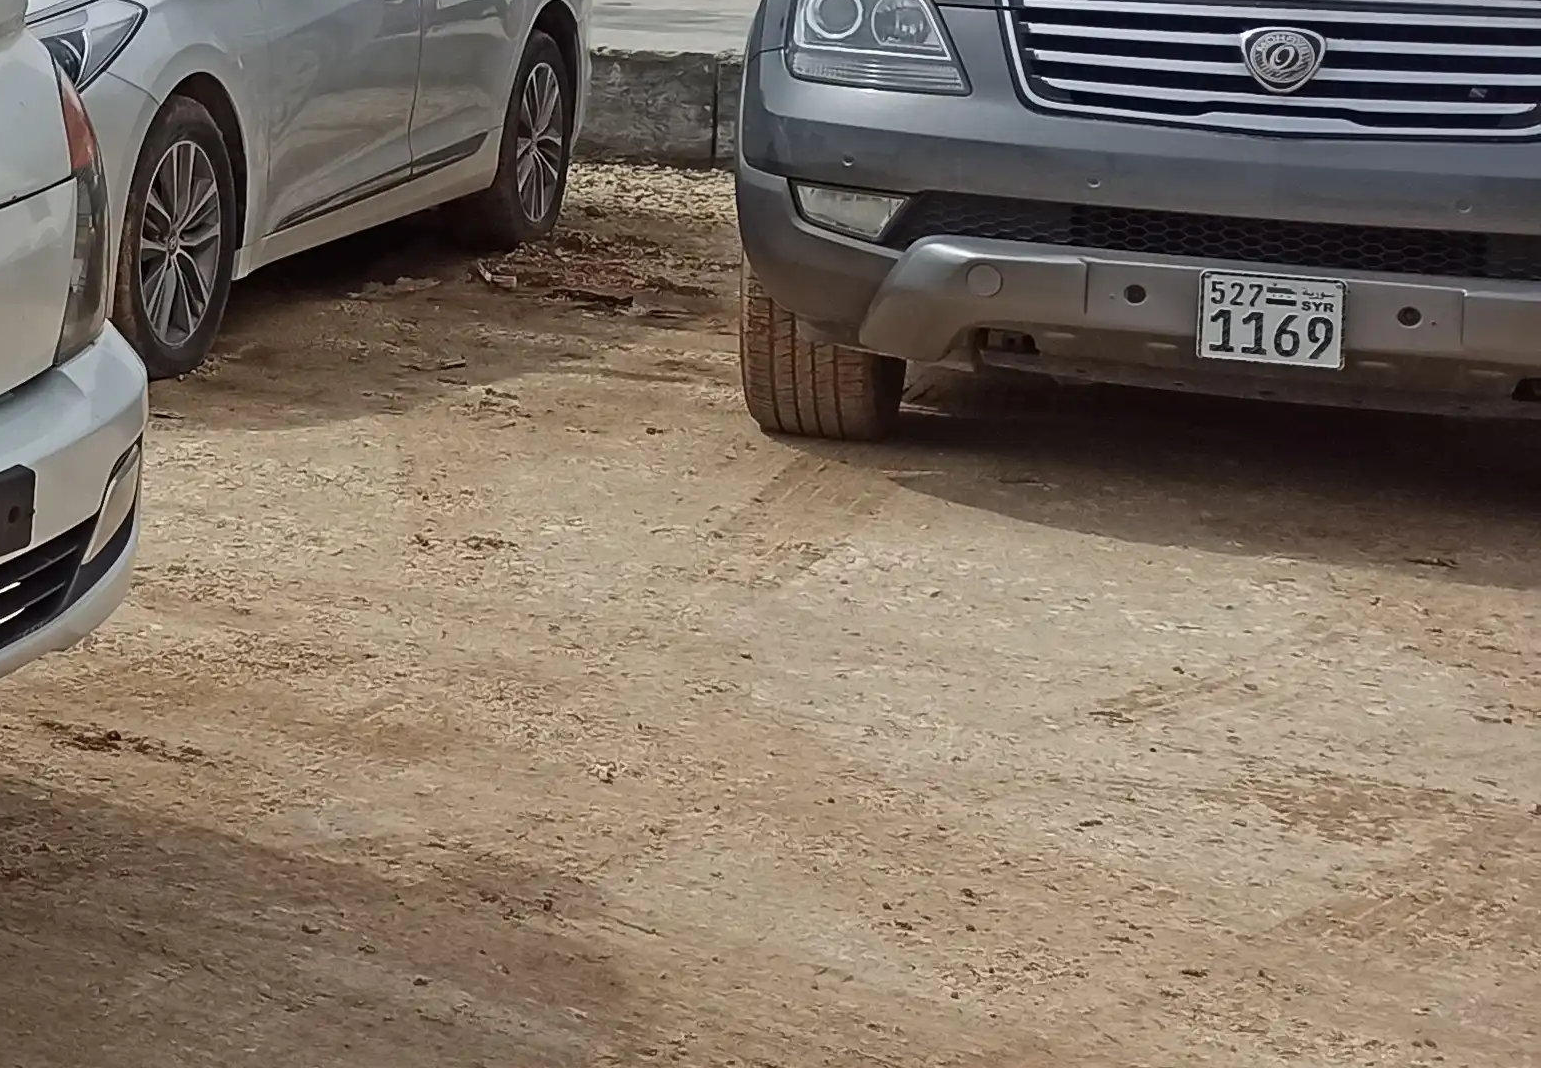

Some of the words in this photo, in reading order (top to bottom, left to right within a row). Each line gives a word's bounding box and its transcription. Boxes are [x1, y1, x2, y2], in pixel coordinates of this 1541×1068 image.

[1211, 280, 1264, 307] 527
[1301, 286, 1335, 300] سورية
[1301, 301, 1335, 313] SYR
[1208, 309, 1335, 360] 1169
